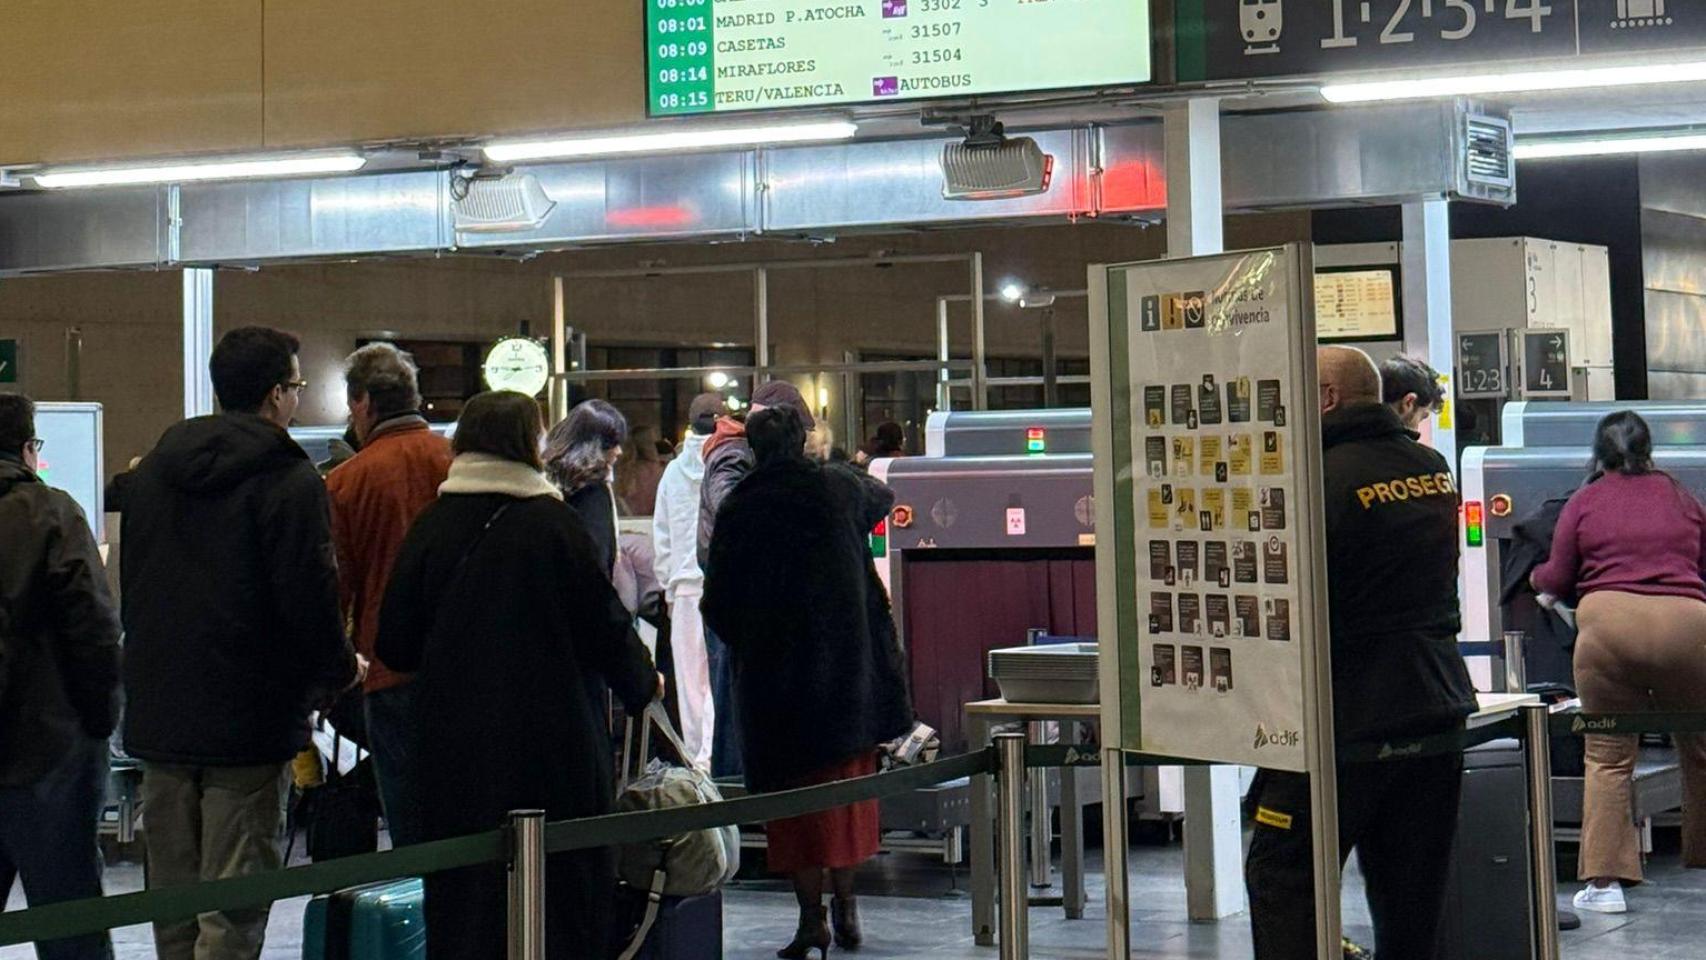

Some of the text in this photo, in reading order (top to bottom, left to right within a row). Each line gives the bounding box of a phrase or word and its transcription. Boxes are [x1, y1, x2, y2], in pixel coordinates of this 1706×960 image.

[658, 5, 865, 33] 08:01 MADRID P.ATOCHA
[659, 41, 707, 58] 08:09
[717, 37, 785, 53] CASETAS
[911, 22, 961, 38] 31507
[660, 66, 707, 83] 08:14
[717, 60, 816, 78] MIRAFLORES
[912, 48, 961, 64] 31504
[660, 91, 708, 108] 08:15
[715, 83, 844, 104] TERU/VALENCIA
[900, 74, 972, 91] AUTOBUS
[1539, 368, 1553, 390] 4
[1269, 729, 1299, 746] adif
